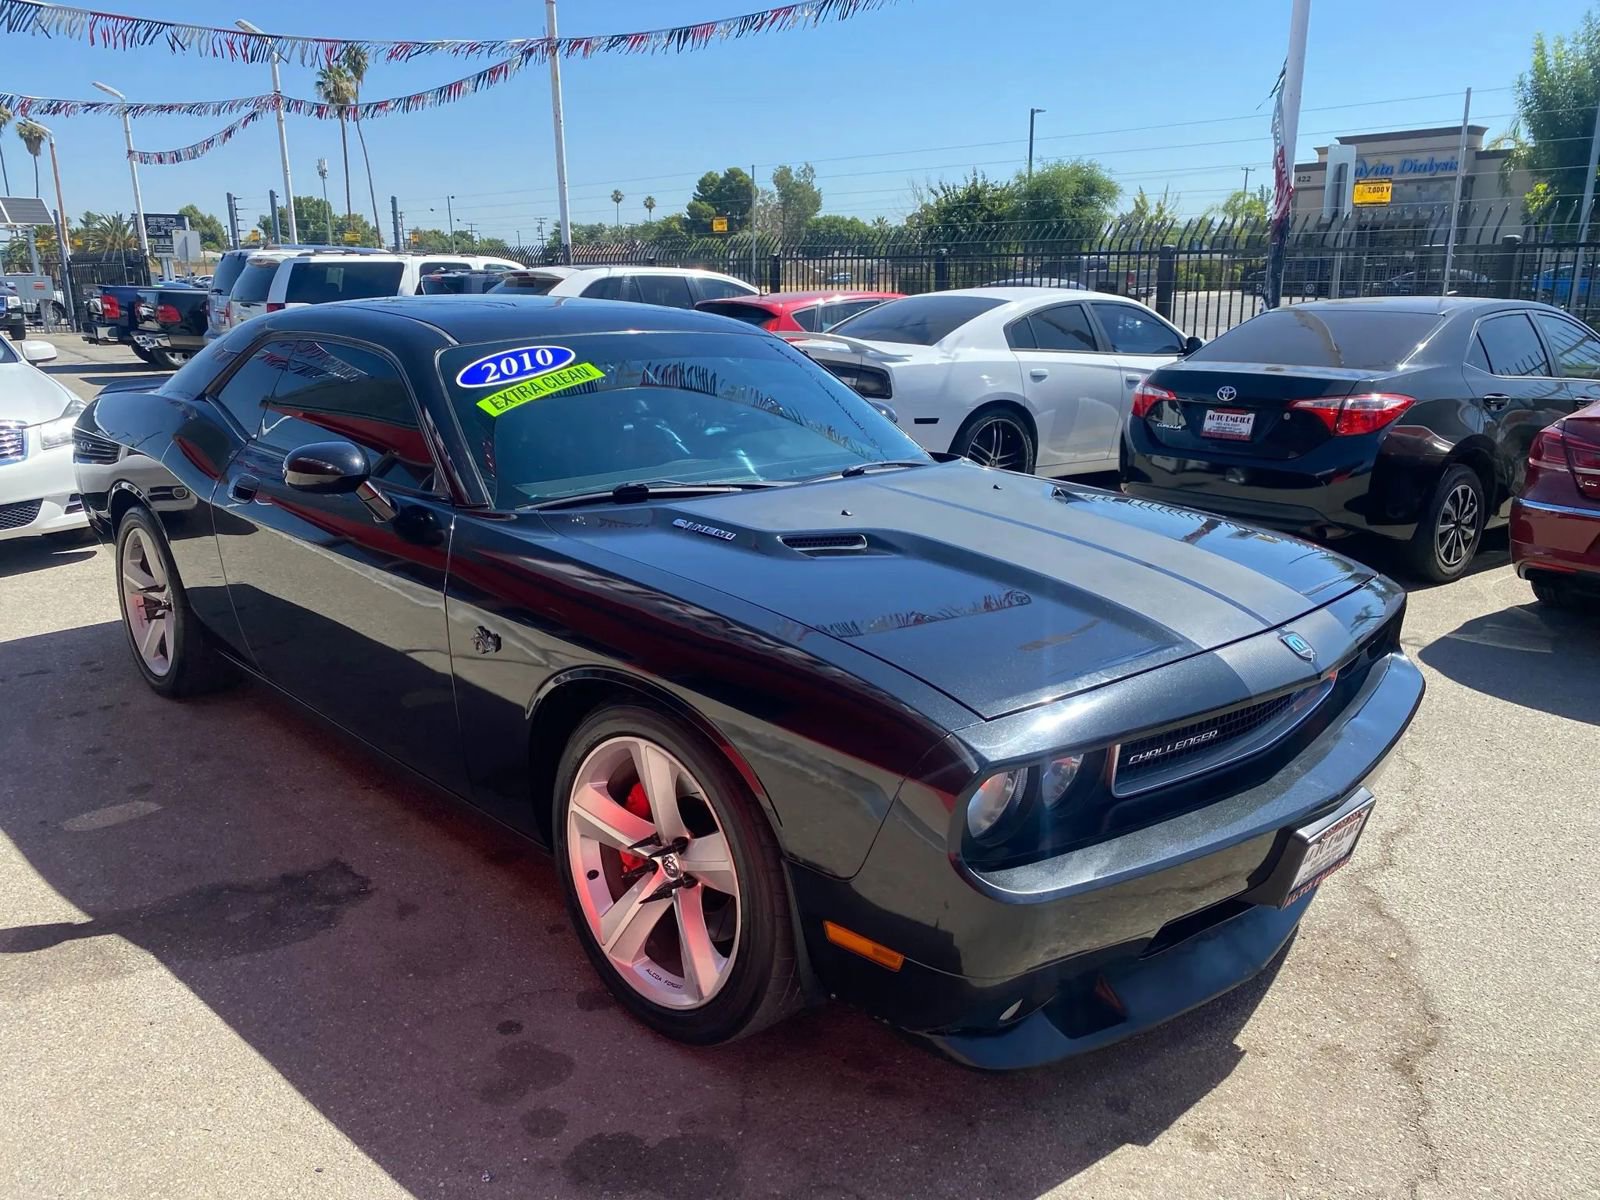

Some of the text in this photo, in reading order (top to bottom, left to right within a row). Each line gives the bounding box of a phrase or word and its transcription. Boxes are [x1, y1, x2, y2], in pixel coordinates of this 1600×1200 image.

[1296, 175, 1312, 183] 422
[481, 348, 554, 383] 2010
[489, 366, 592, 410] EXTRA CLEAN
[1207, 413, 1225, 422] AUTO
[1128, 729, 1218, 765] CHALLENGER
[646, 968, 662, 981] ALCOA
